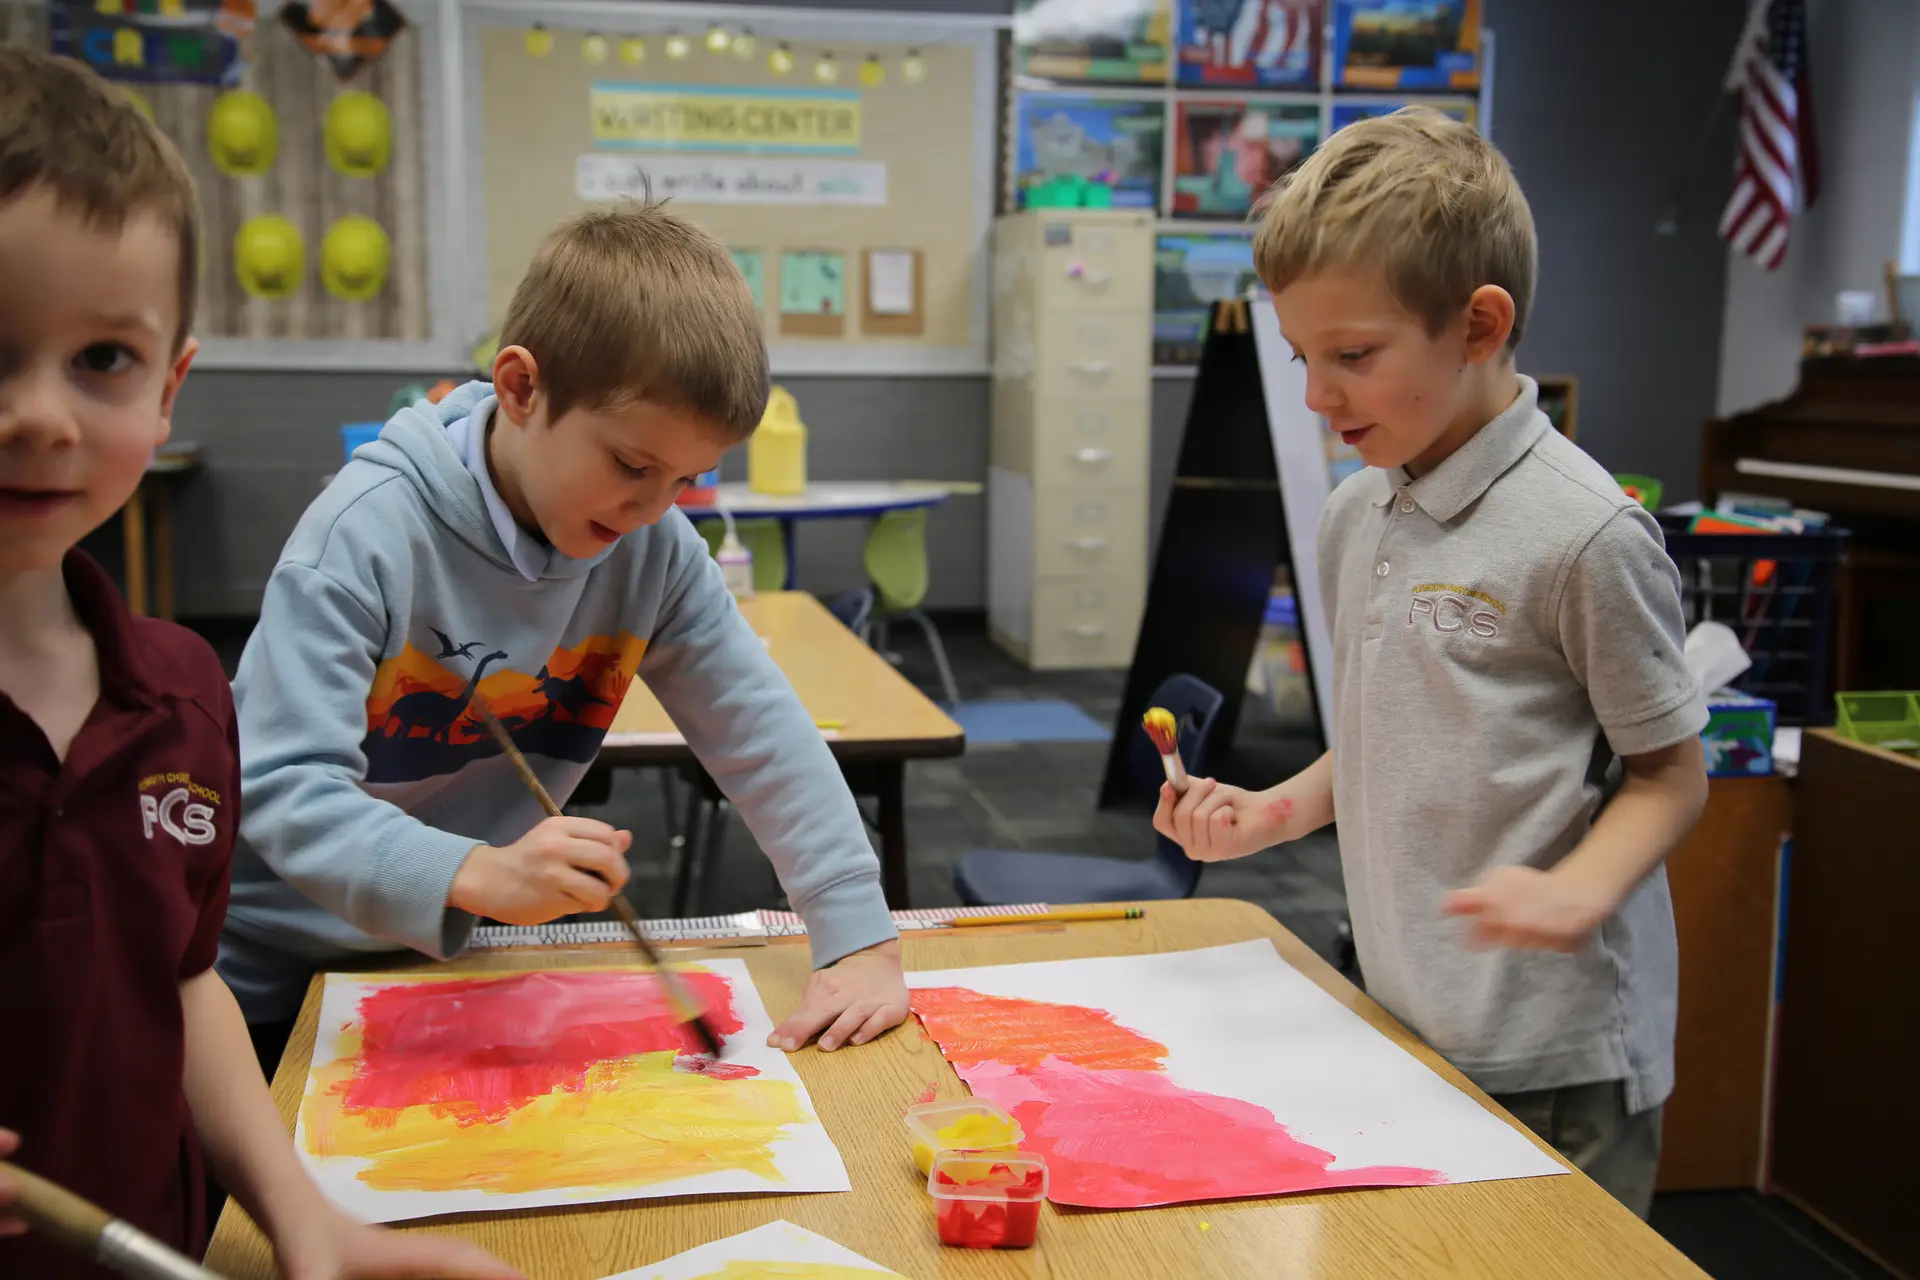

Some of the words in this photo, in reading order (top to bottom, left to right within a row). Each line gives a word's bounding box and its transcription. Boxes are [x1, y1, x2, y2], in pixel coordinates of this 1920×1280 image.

[740, 106, 855, 138] CENTER
[736, 170, 804, 195] about
[1406, 595, 1499, 640] PCS
[140, 787, 216, 847] PCS
